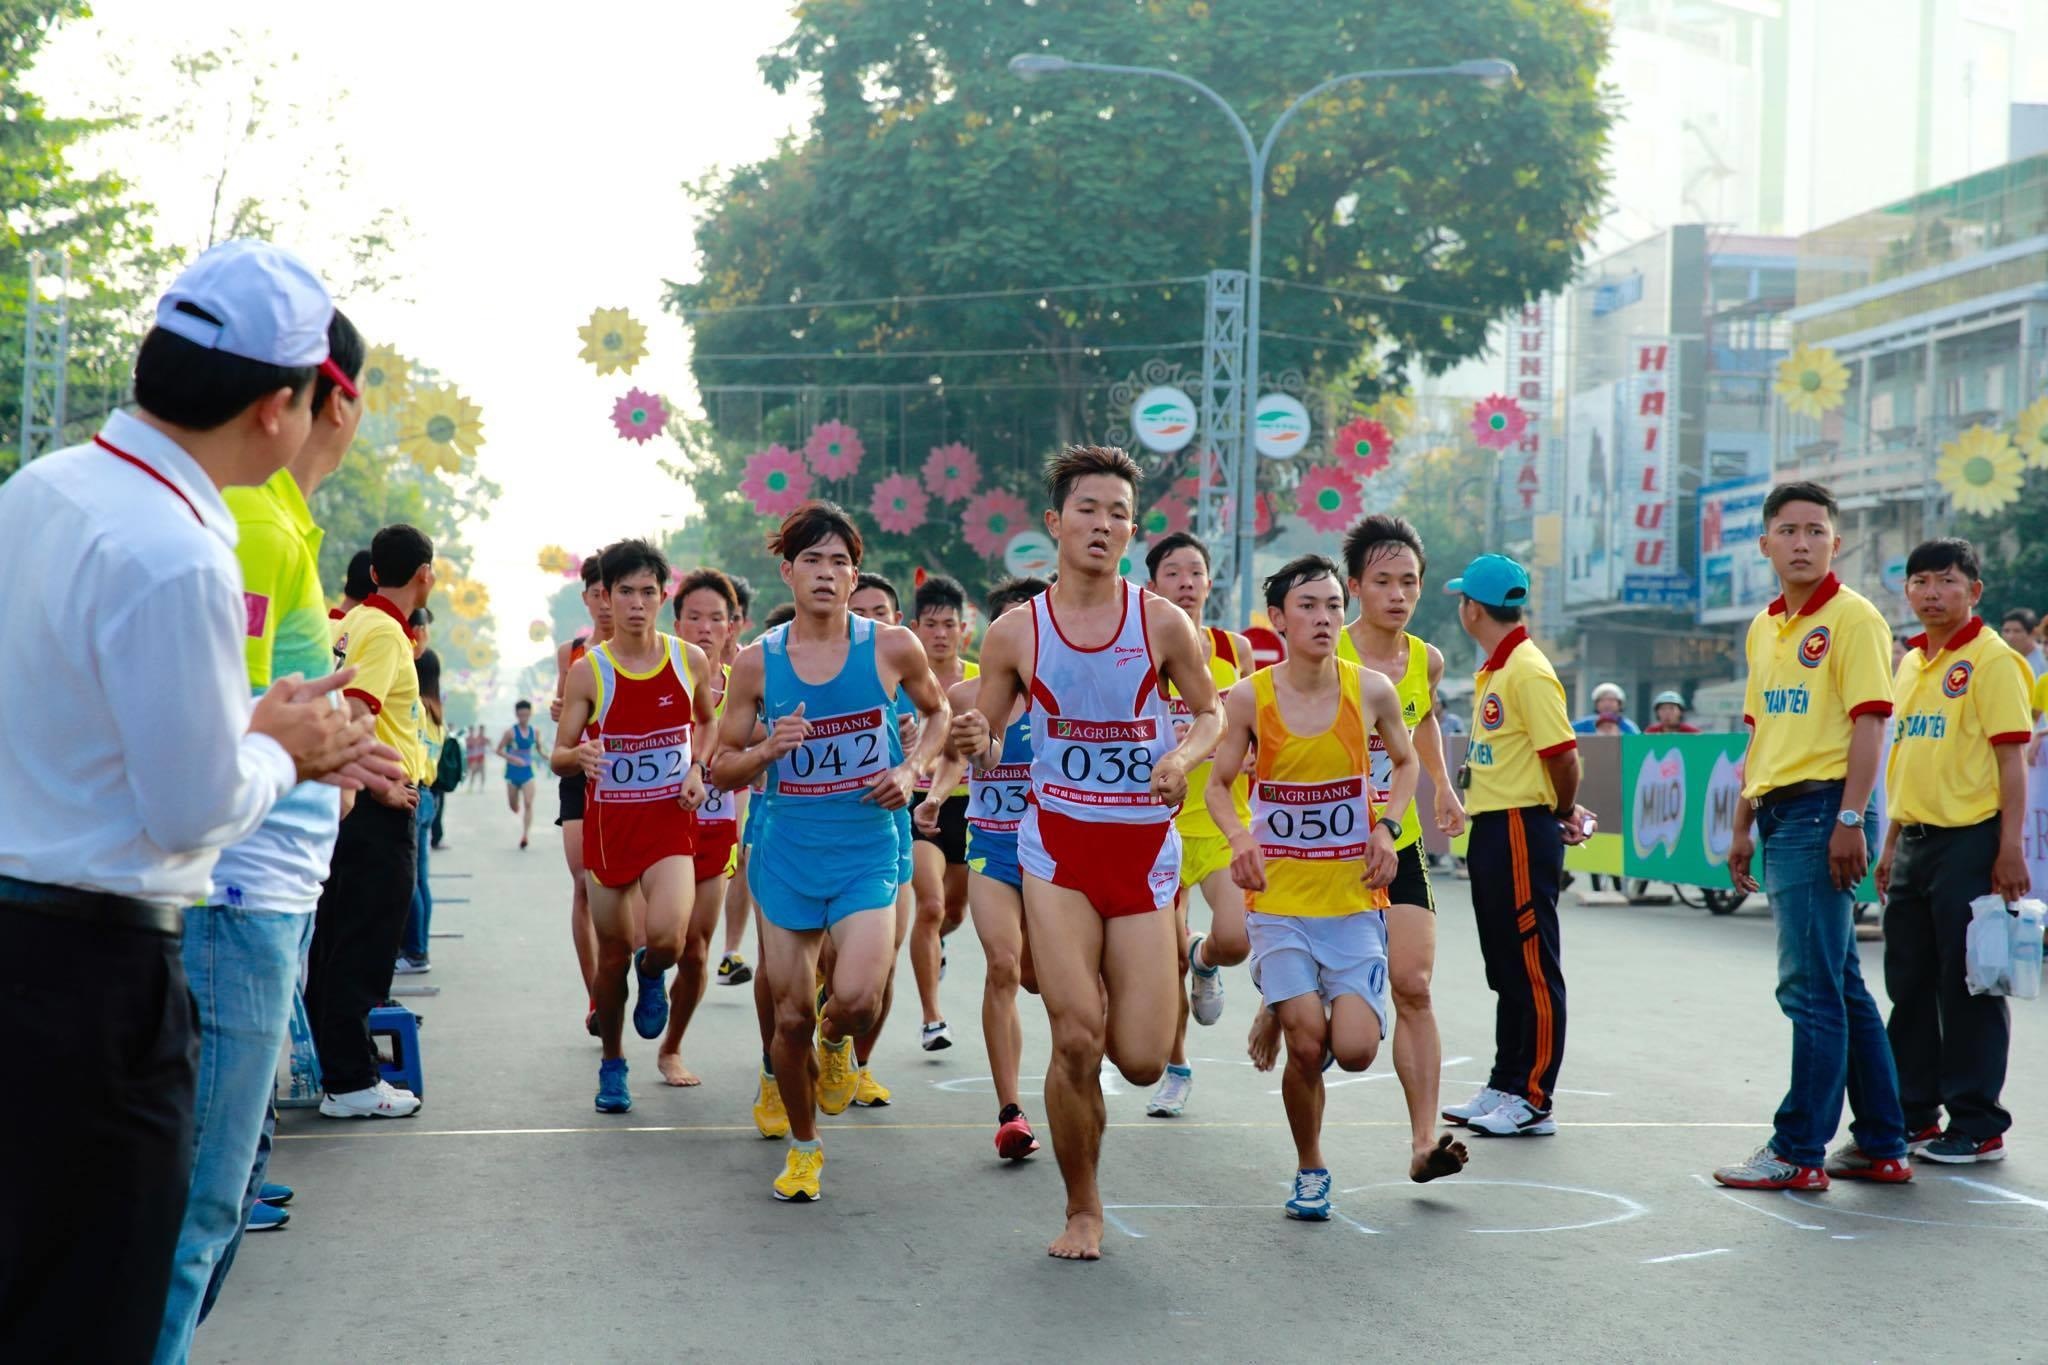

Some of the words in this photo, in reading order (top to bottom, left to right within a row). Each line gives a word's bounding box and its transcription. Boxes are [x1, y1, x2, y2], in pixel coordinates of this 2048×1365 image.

[623, 733, 682, 753] AGRIBANK
[1071, 725, 1149, 740] AGRIBANK
[612, 750, 683, 784] 052
[791, 734, 880, 778] 042
[1061, 745, 1154, 784] 038
[1278, 785, 1352, 802] AGRIBANK
[1641, 780, 1680, 831] MILO
[1268, 803, 1354, 840] 050
